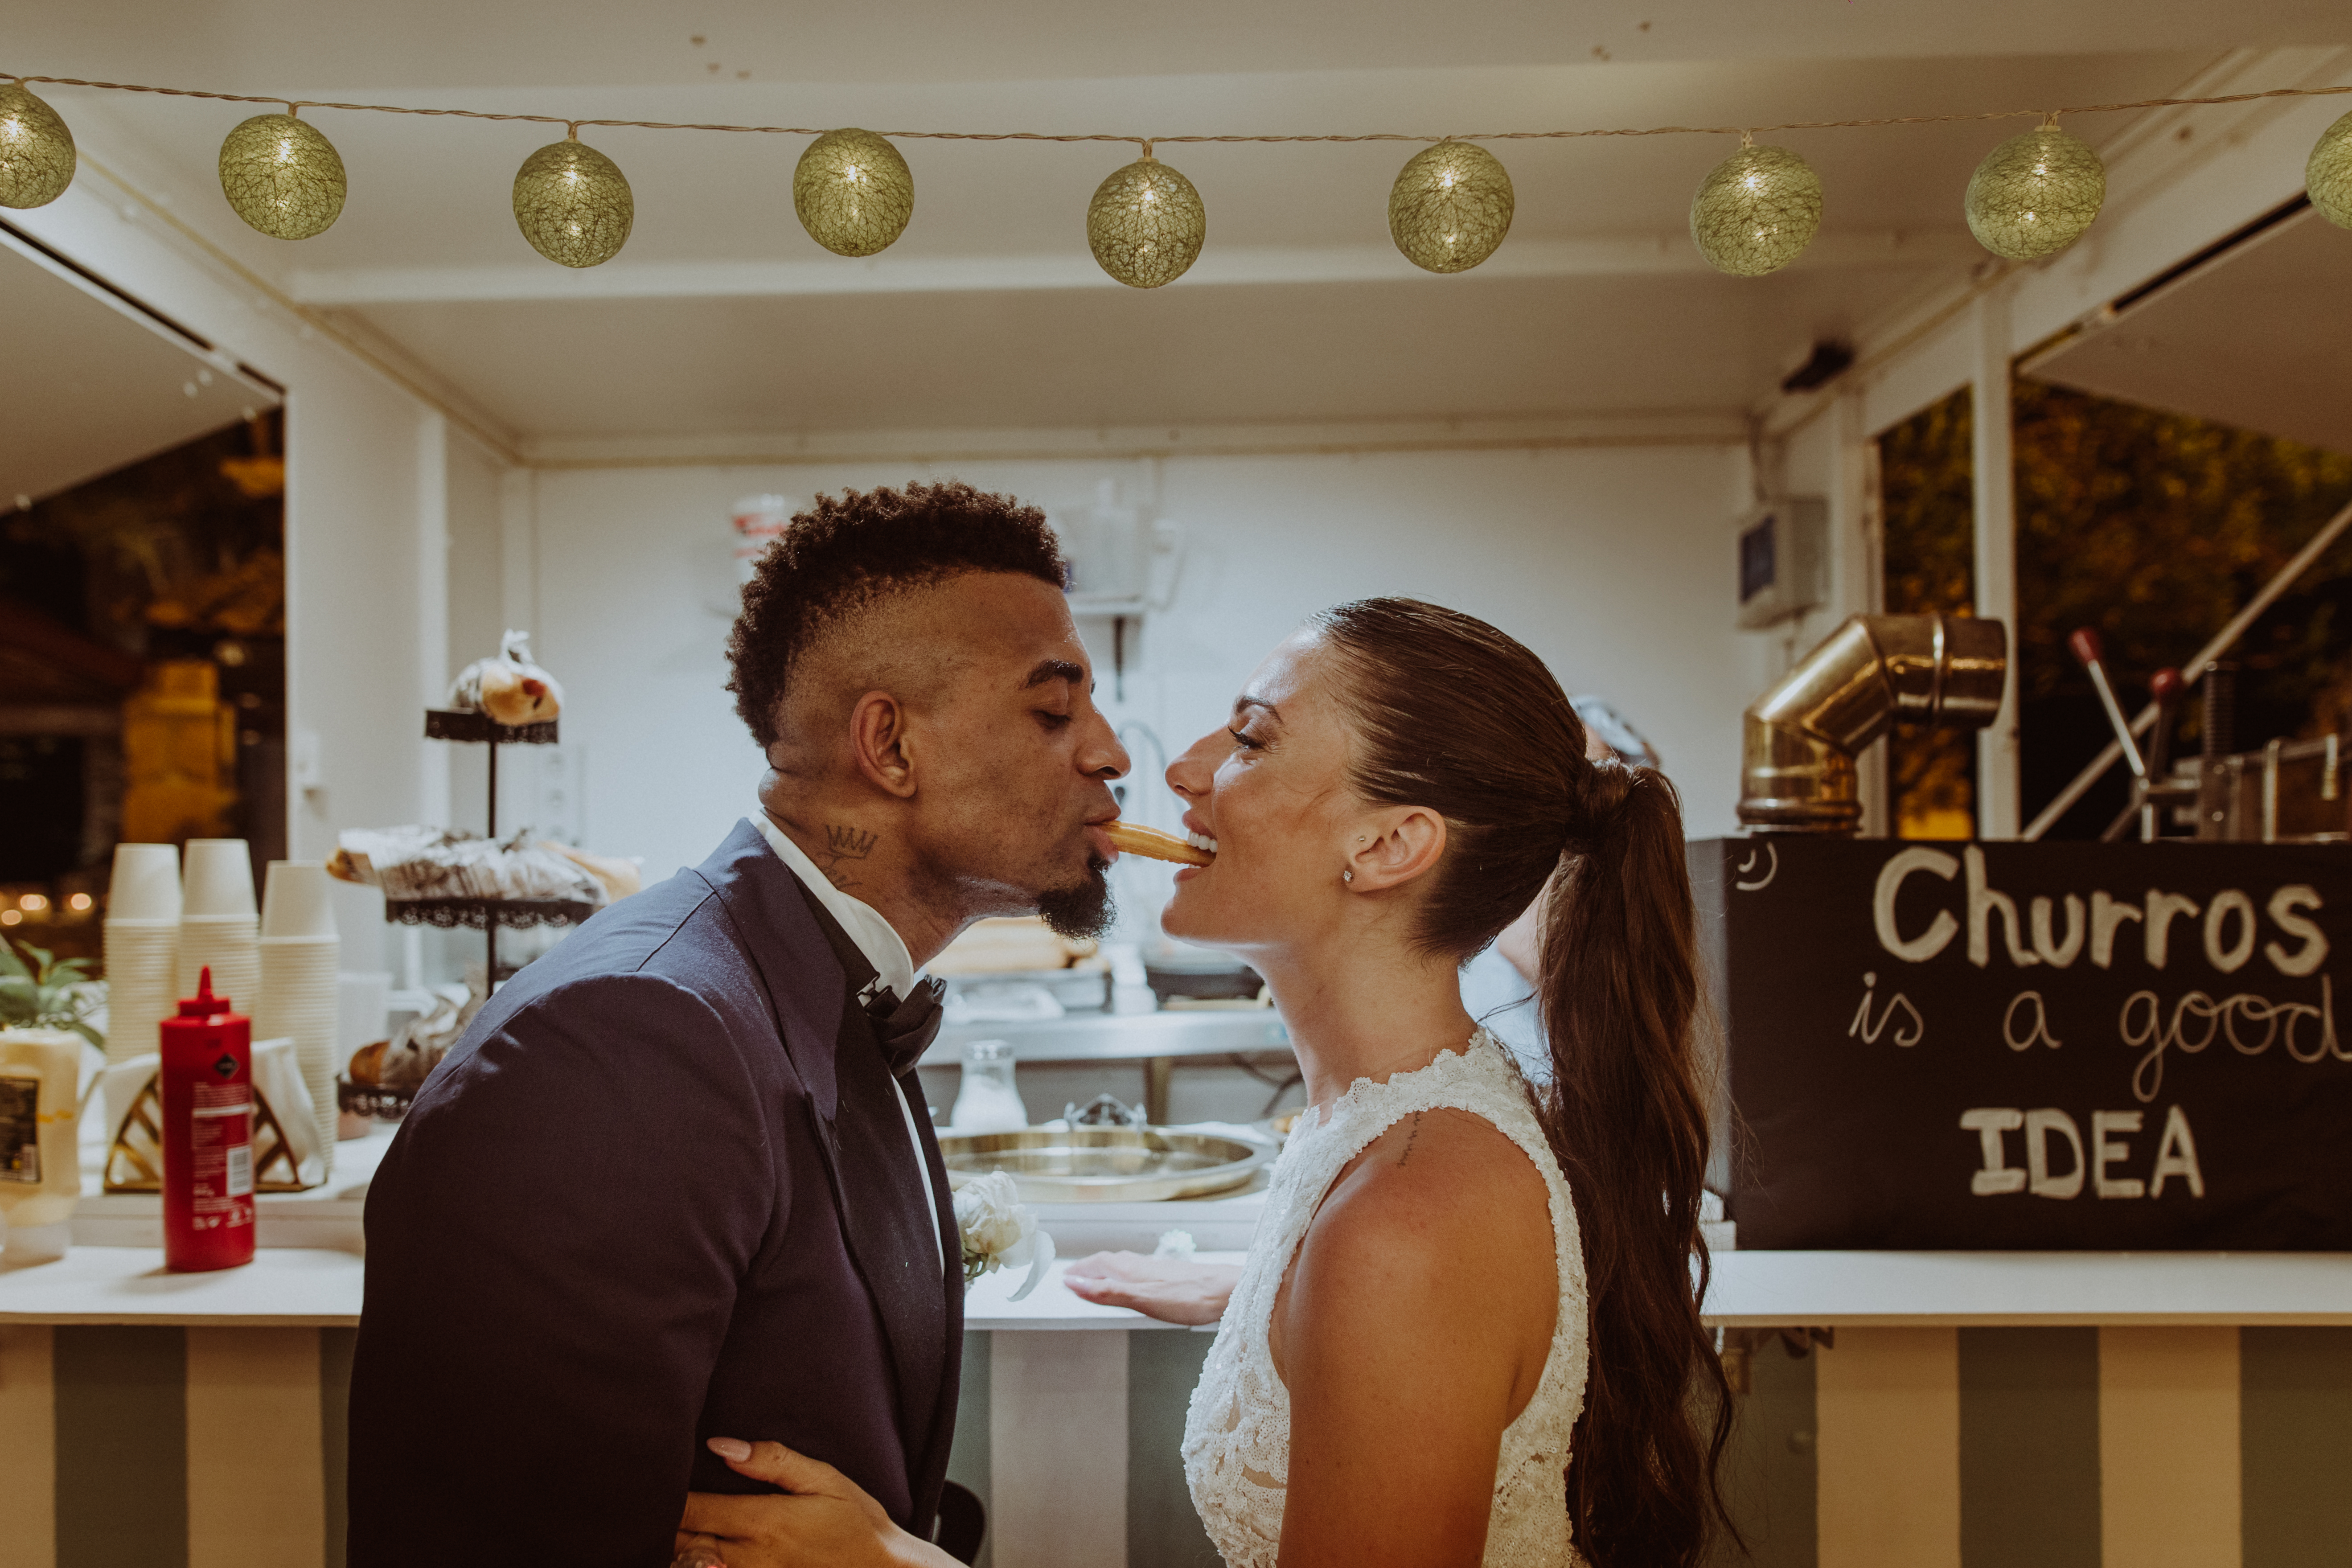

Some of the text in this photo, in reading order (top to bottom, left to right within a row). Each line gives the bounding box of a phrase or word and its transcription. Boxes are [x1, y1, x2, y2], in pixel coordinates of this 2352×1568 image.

[1873, 845, 2328, 977] Churros
[1848, 971, 2352, 1102] is a good
[1959, 1105, 2204, 1199] IDEA
